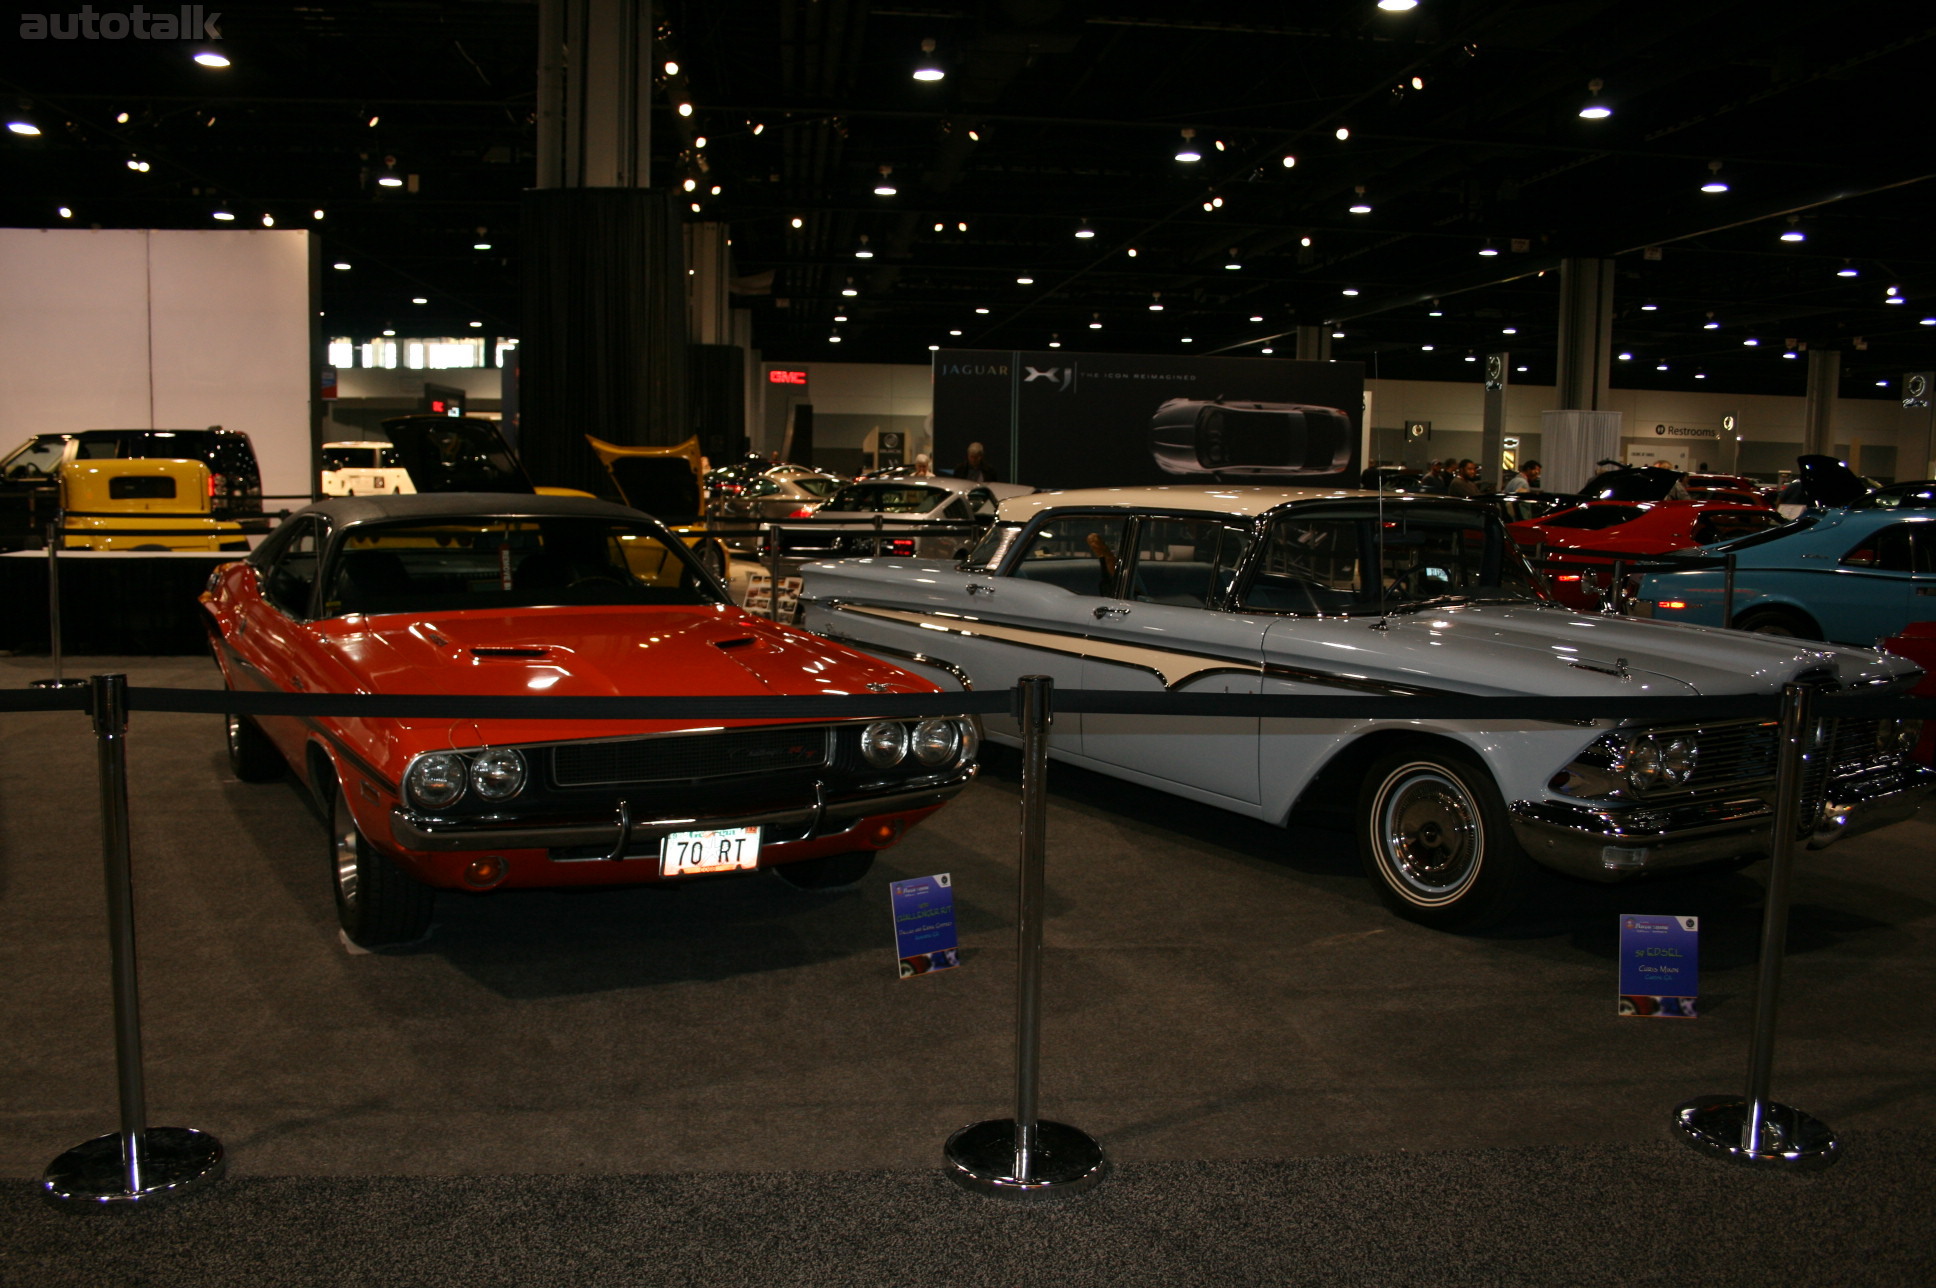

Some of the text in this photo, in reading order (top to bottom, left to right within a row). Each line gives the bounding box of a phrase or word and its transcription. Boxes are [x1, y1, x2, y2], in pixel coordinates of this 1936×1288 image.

[942, 364, 1009, 377] JAGUAR
[1080, 371, 1100, 379] THE
[1134, 373, 1197, 382] REIMAGINED
[769, 370, 807, 385] GMC
[1667, 425, 1716, 437] Restrooms
[677, 838, 746, 866] 70 RT
[1646, 946, 1684, 958] EDSEL
